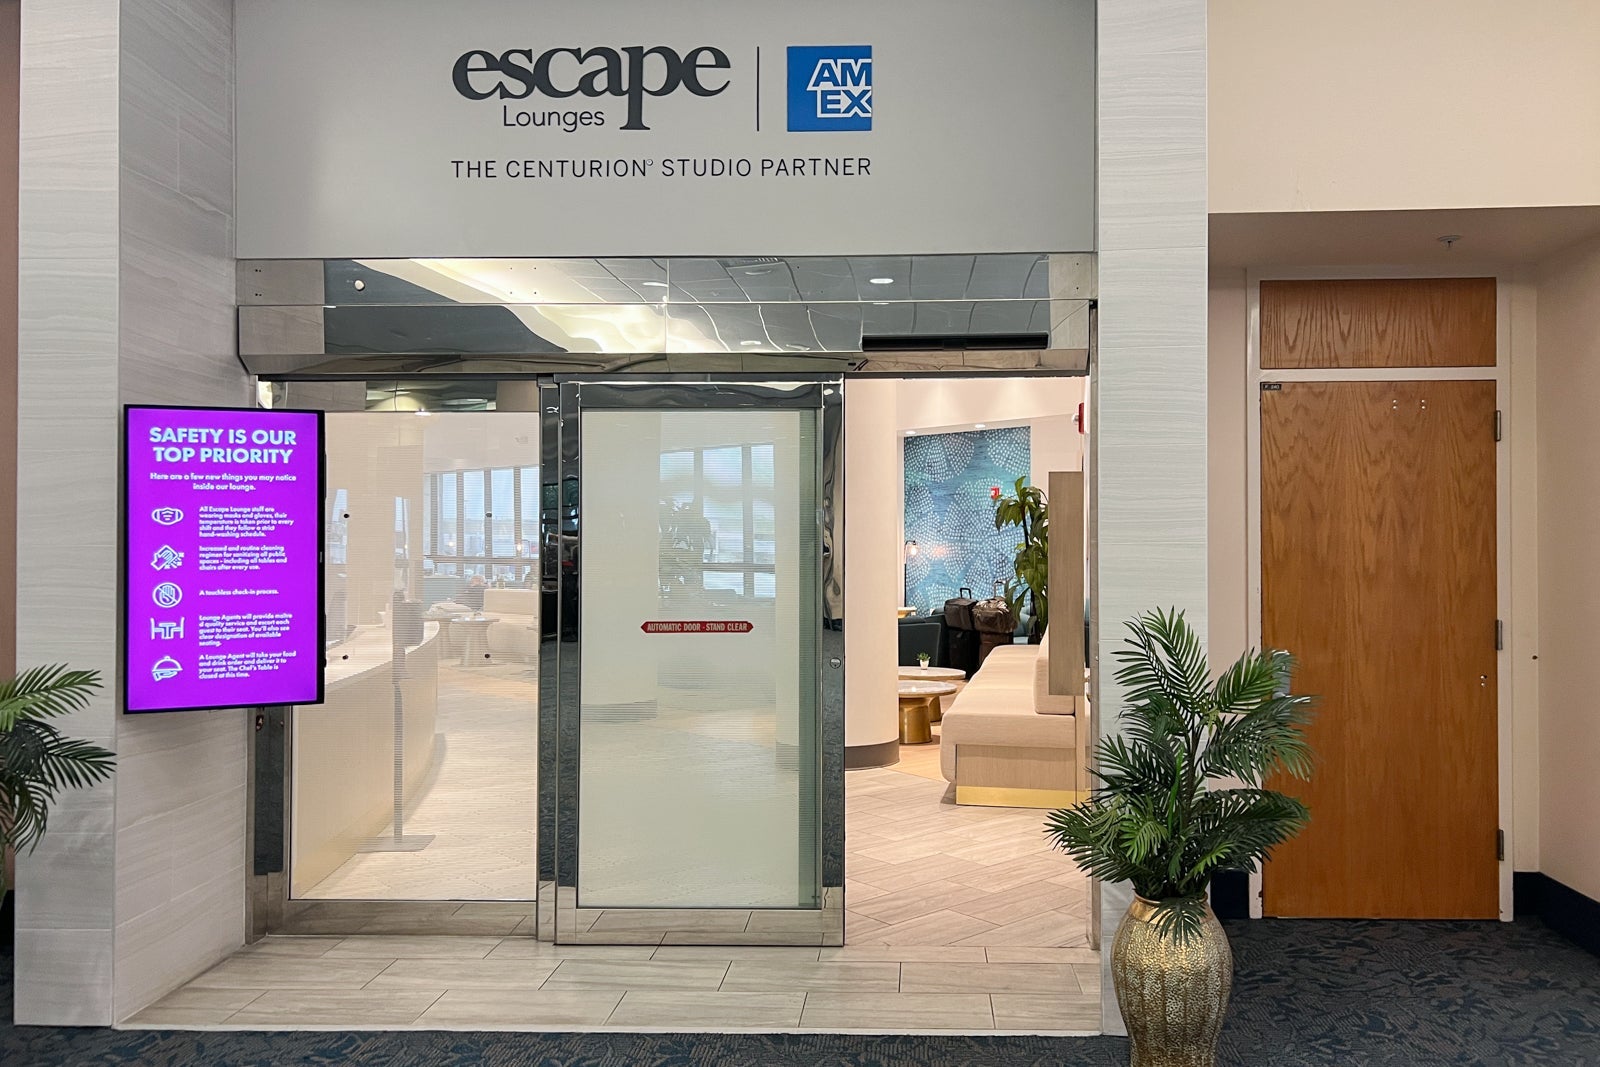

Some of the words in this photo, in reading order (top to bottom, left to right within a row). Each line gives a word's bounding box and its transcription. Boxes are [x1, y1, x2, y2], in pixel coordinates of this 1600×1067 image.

[807, 57, 872, 91] AM
[452, 45, 731, 130] escape
[816, 89, 872, 119] EX
[503, 104, 605, 133] Lounges
[451, 160, 498, 178] THE
[662, 158, 752, 177] STUDIO
[761, 157, 871, 177] PARTNER
[149, 427, 224, 443] SAFETY
[229, 429, 247, 444] IS
[251, 429, 297, 445] OUR
[153, 447, 195, 463] TOP
[200, 448, 293, 464] PRIORITY
[150, 472, 168, 480] Here
[190, 472, 204, 481] few
[221, 473, 243, 482] things
[243, 475, 258, 483] you
[259, 475, 275, 483] may
[275, 473, 297, 481] notice
[192, 482, 215, 490] inside
[229, 483, 256, 492] lounge.
[647, 623, 682, 632] AUTOMATIC
[683, 623, 701, 632] DOOR
[705, 622, 725, 631] STAND
[727, 622, 748, 631] CLEAR
